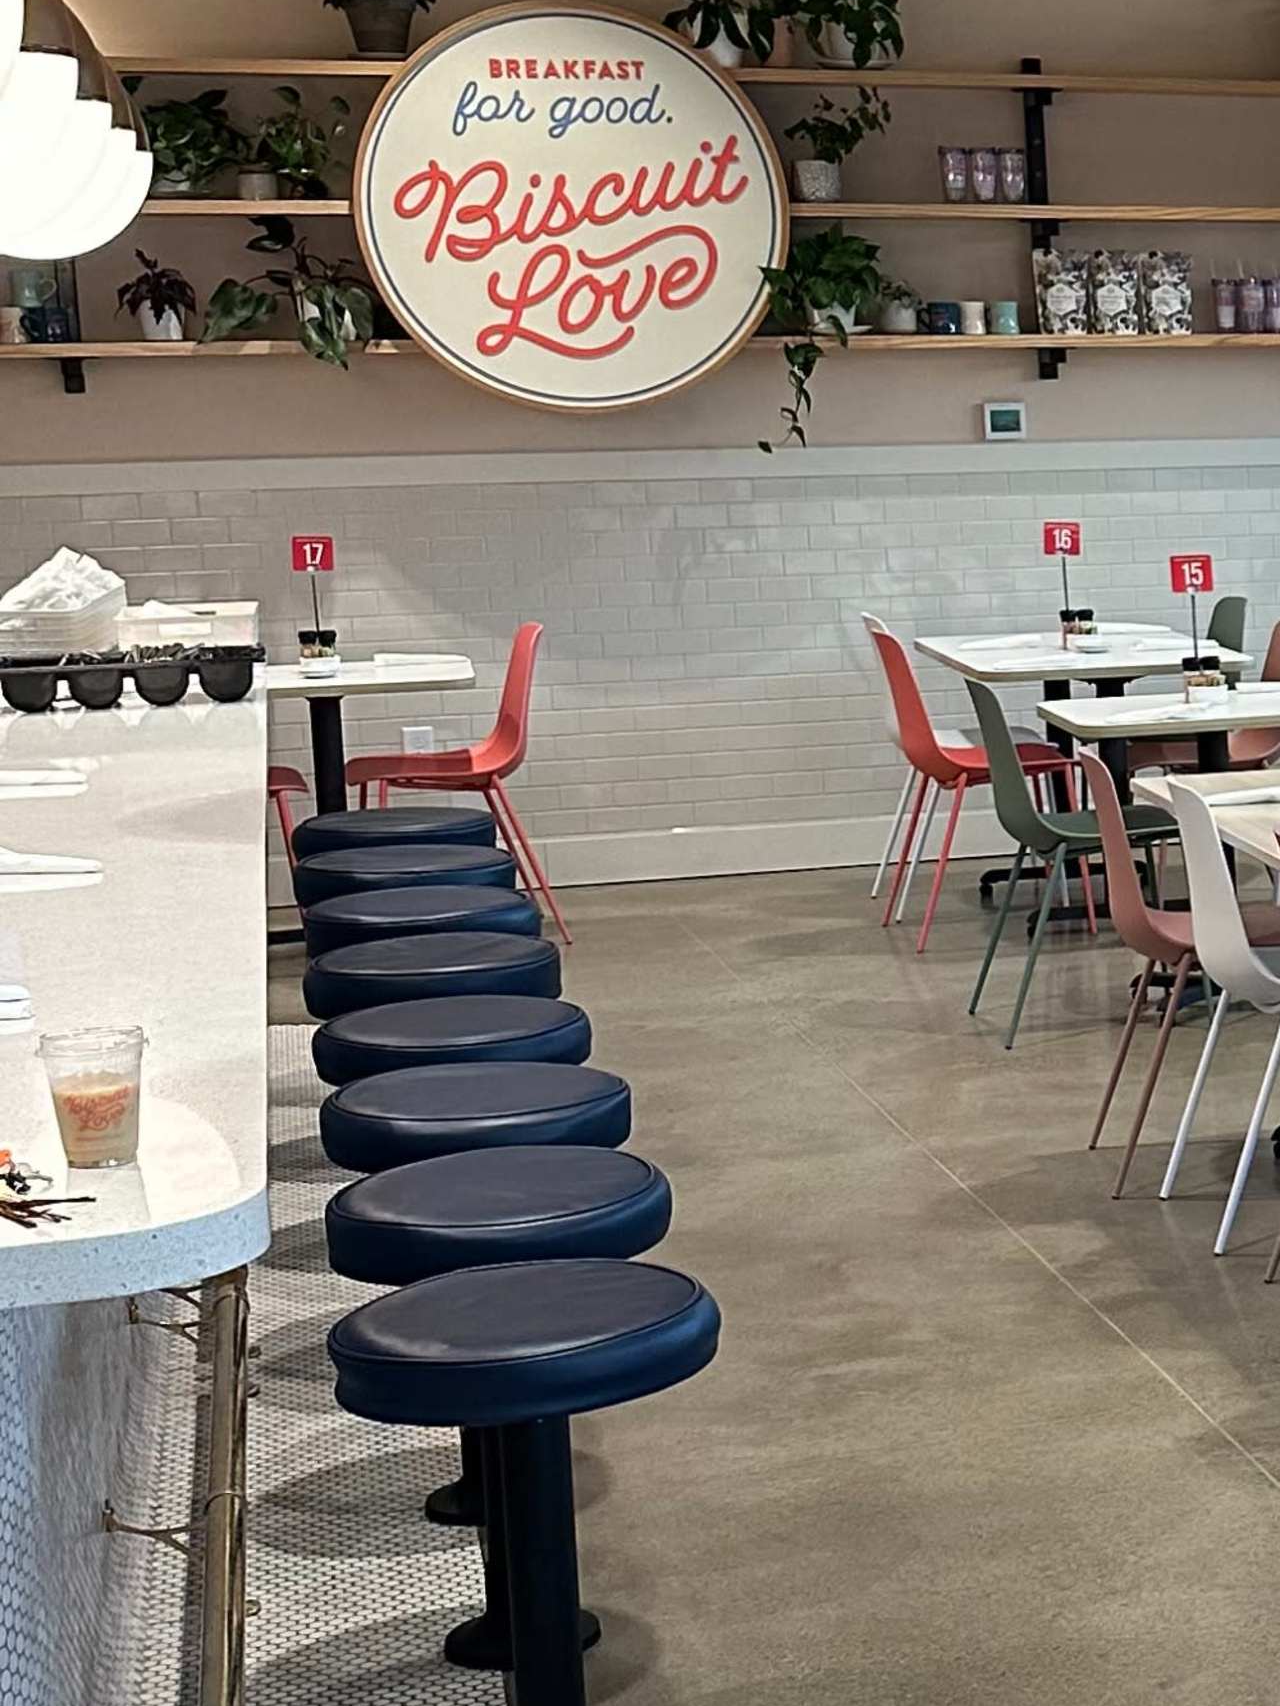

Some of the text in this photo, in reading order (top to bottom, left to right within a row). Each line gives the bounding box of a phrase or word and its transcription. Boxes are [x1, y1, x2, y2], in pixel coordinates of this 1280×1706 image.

[488, 58, 645, 80] BREAKFAST
[452, 80, 674, 139] for good.
[393, 135, 749, 263] Biscuit
[476, 224, 719, 360] Love
[1052, 528, 1072, 549] 16
[302, 543, 324, 564] 17
[1181, 562, 1204, 585] 15
